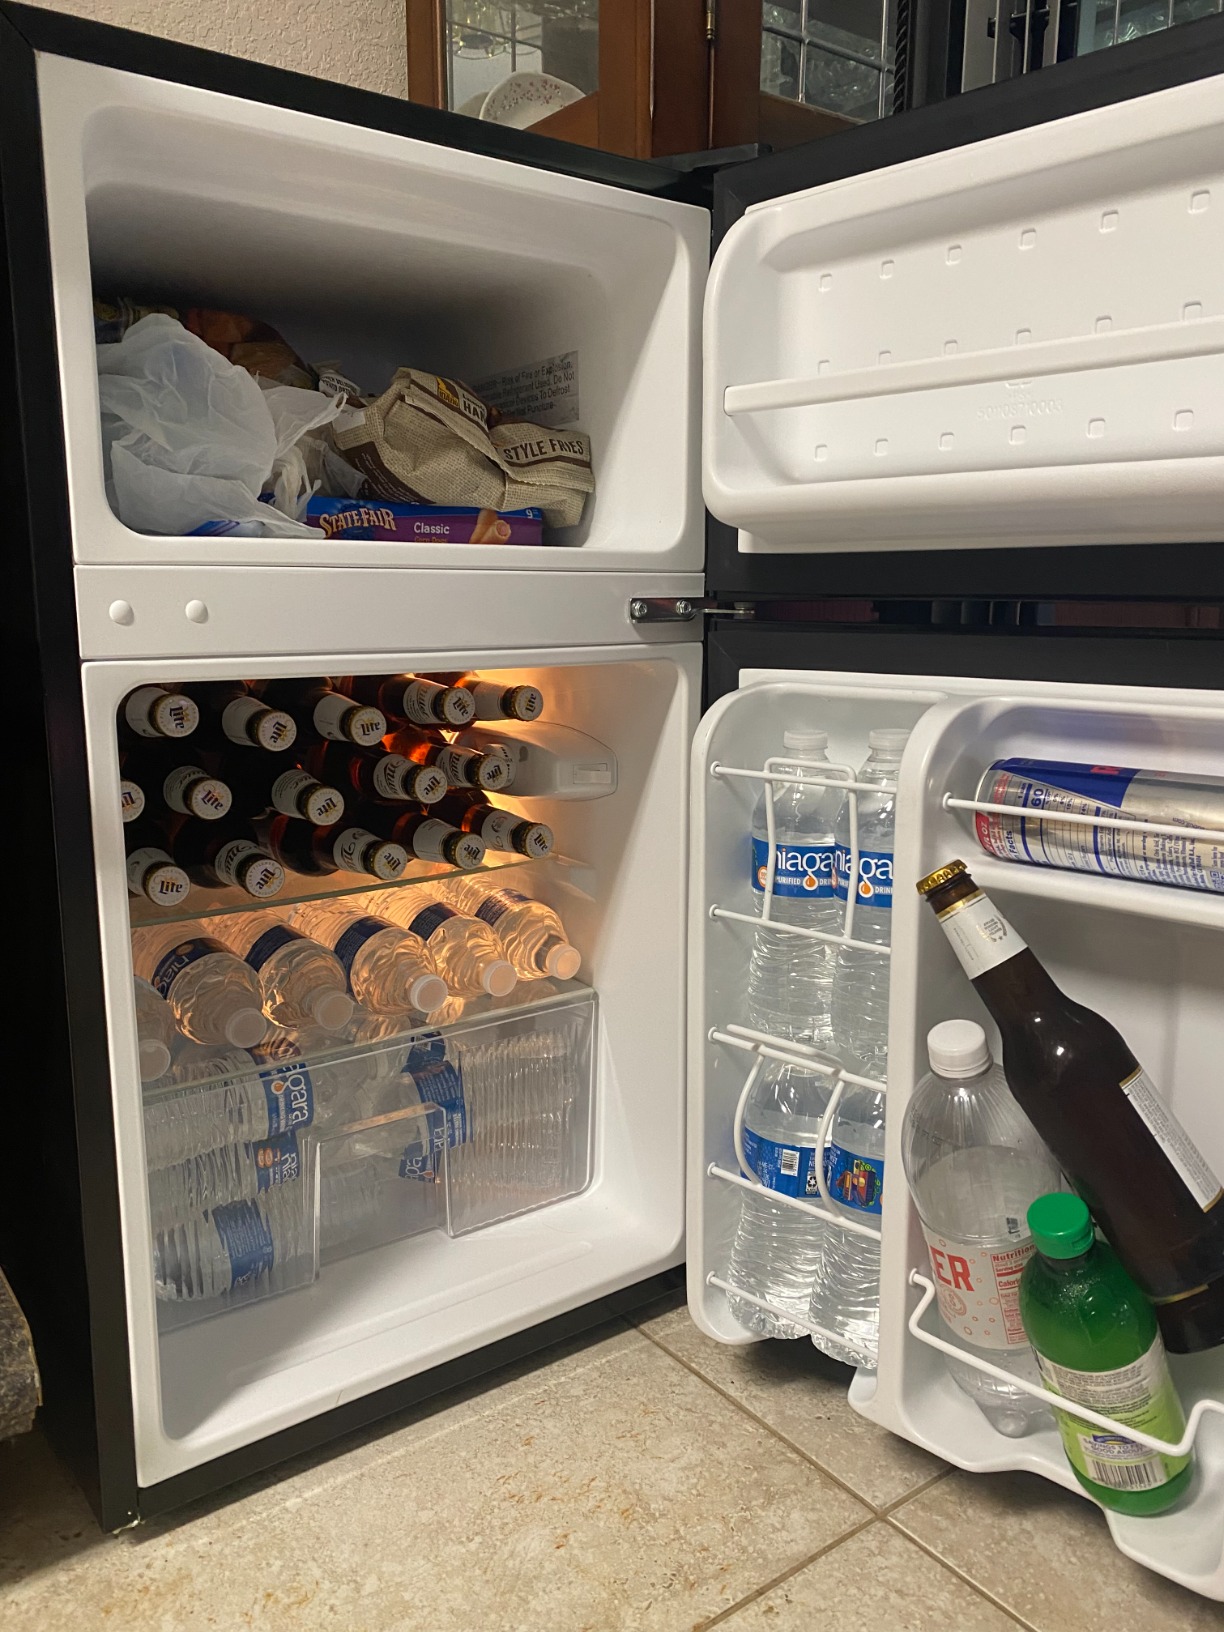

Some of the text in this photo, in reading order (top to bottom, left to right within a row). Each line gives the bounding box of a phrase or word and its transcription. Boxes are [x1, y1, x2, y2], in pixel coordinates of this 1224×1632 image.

[503, 439, 584, 461] STYLE FRIES
[413, 521, 451, 535] Classic
[452, 698, 469, 718] Lite
[525, 693, 537, 714] Lite
[170, 706, 185, 730] Lite
[360, 720, 382, 731] Lite
[270, 721, 288, 744] Lite
[486, 763, 504, 781] Lite
[425, 775, 442, 797] Lite
[201, 790, 225, 812] Lite
[316, 797, 338, 817] Lite
[533, 833, 548, 852] Lite
[1005, 830, 1018, 853] Facts
[384, 852, 402, 873] Lite
[464, 845, 481, 862] Lite
[159, 880, 184, 895] Lite
[256, 867, 277, 891] Lite
[992, 1244, 1035, 1262] Nutrition
[930, 1245, 975, 1292] ER
